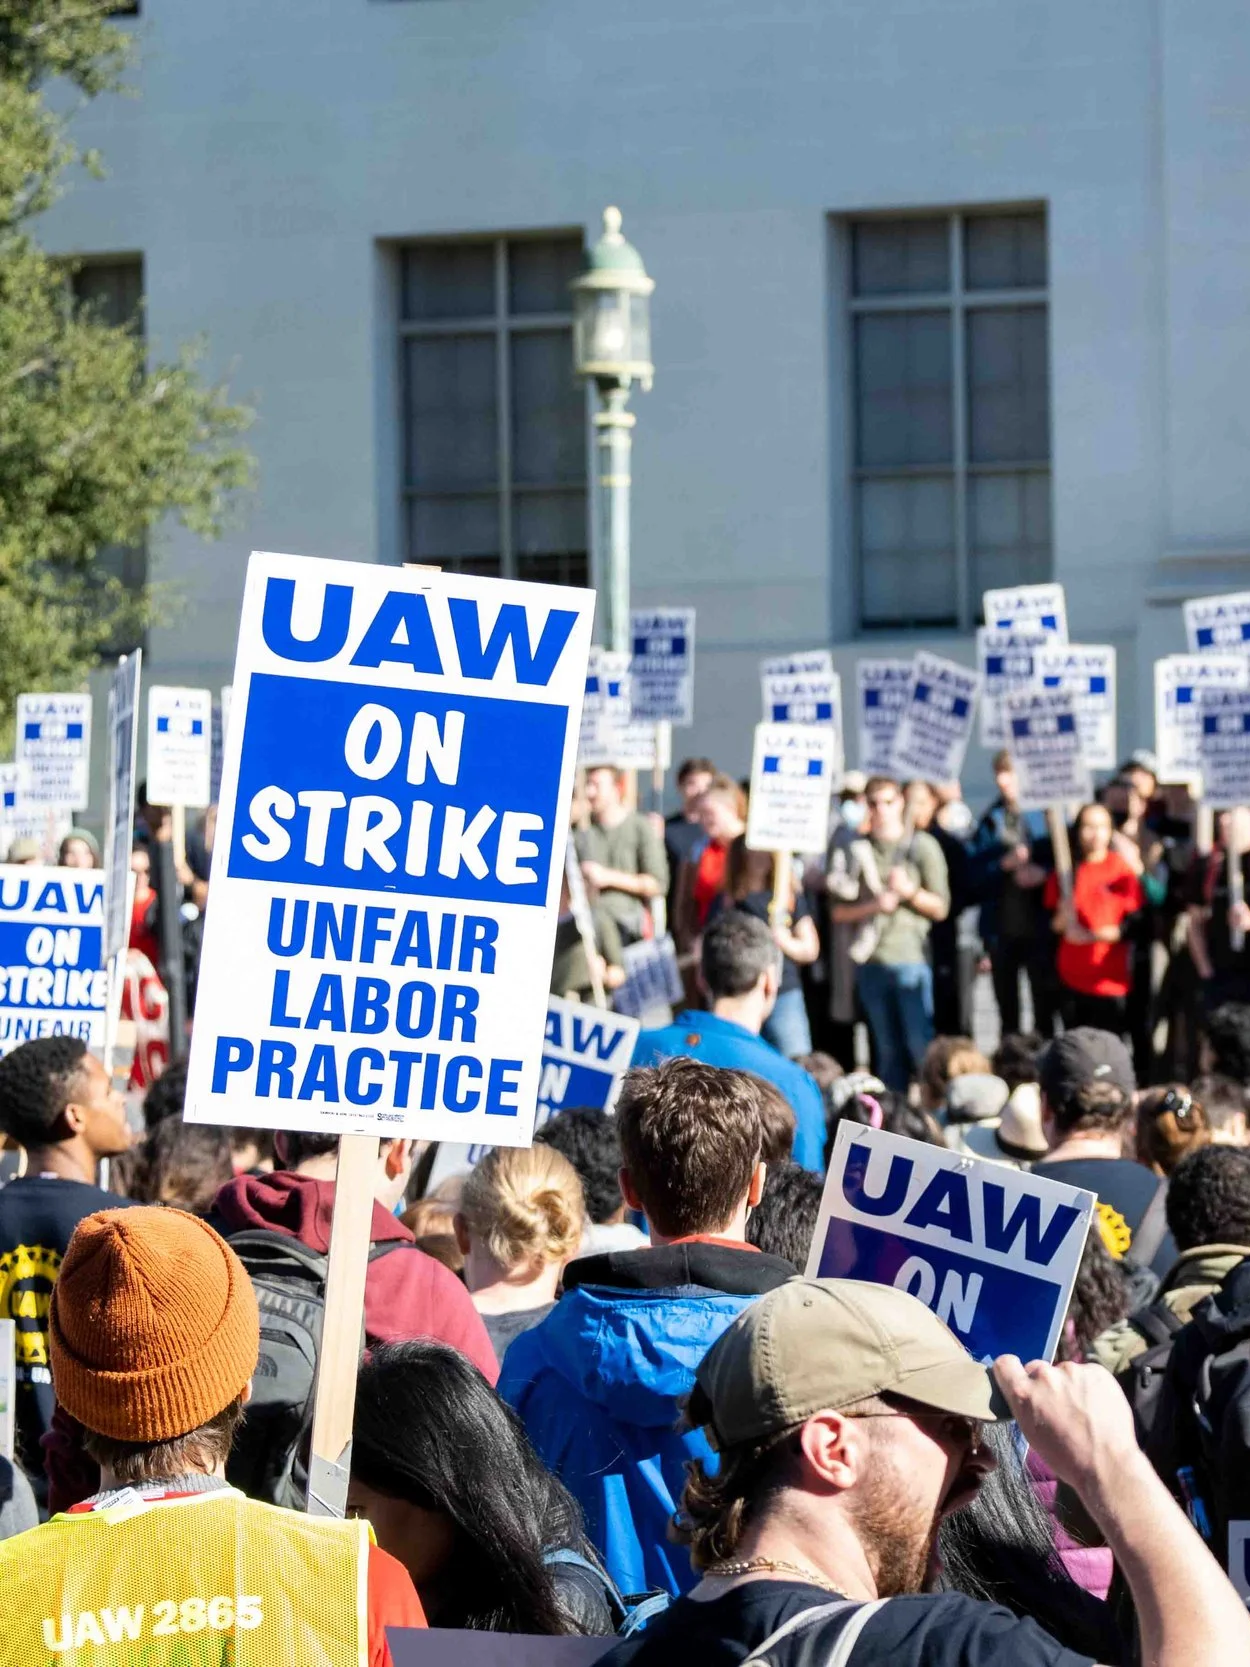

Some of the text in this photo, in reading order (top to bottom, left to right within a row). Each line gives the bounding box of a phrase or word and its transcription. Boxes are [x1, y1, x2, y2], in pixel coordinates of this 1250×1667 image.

[262, 576, 580, 687] UAW
[344, 702, 465, 786] ON
[241, 785, 544, 886] STRIKE
[26, 926, 82, 966] ON
[267, 897, 500, 975] UNFAIR
[270, 970, 481, 1043] LABOR
[544, 1010, 626, 1061] AW
[211, 1036, 523, 1117] PRACTICE
[538, 1063, 572, 1104] N
[842, 1142, 1081, 1266] UAW
[893, 1255, 984, 1334] ON
[43, 1594, 264, 1652] UAW 2865
